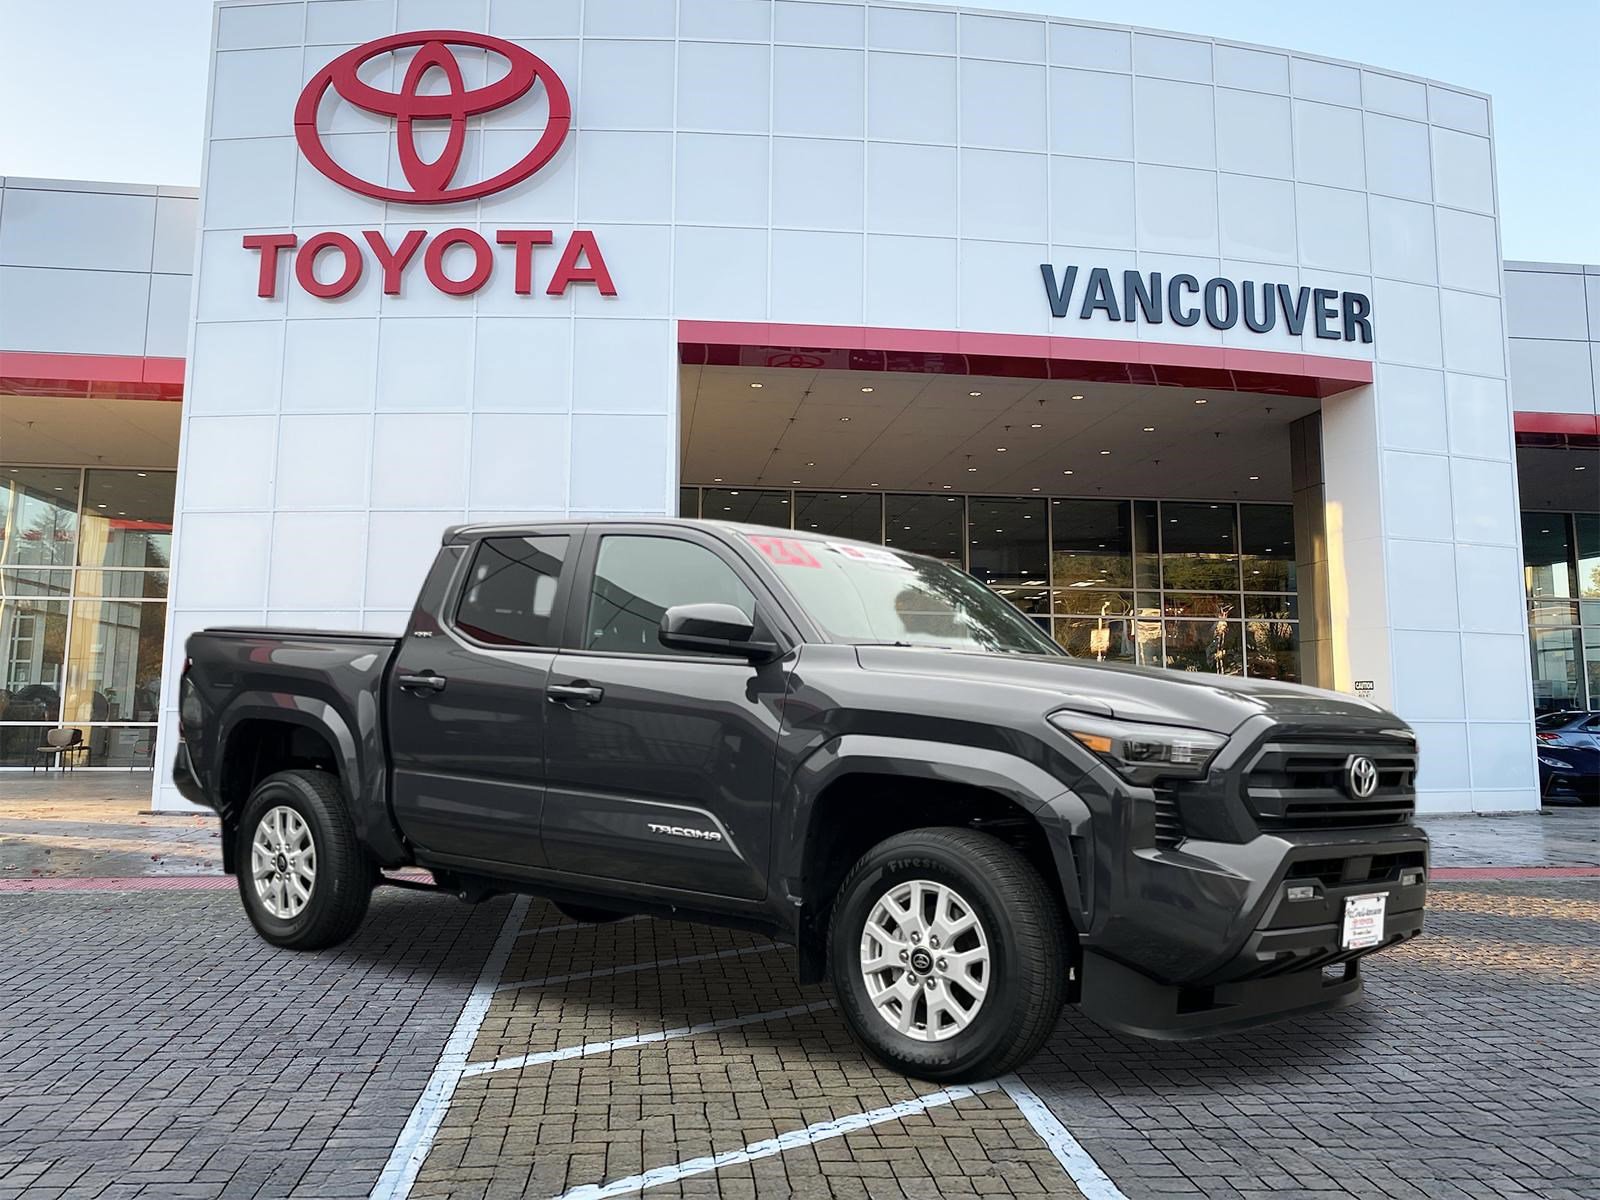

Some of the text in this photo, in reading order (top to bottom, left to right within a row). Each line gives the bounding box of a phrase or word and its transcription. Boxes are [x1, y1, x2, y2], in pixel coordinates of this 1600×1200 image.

[243, 228, 617, 298] TOYOTA
[1040, 264, 1373, 343] VANCOUVER
[647, 823, 721, 842] TACOMA
